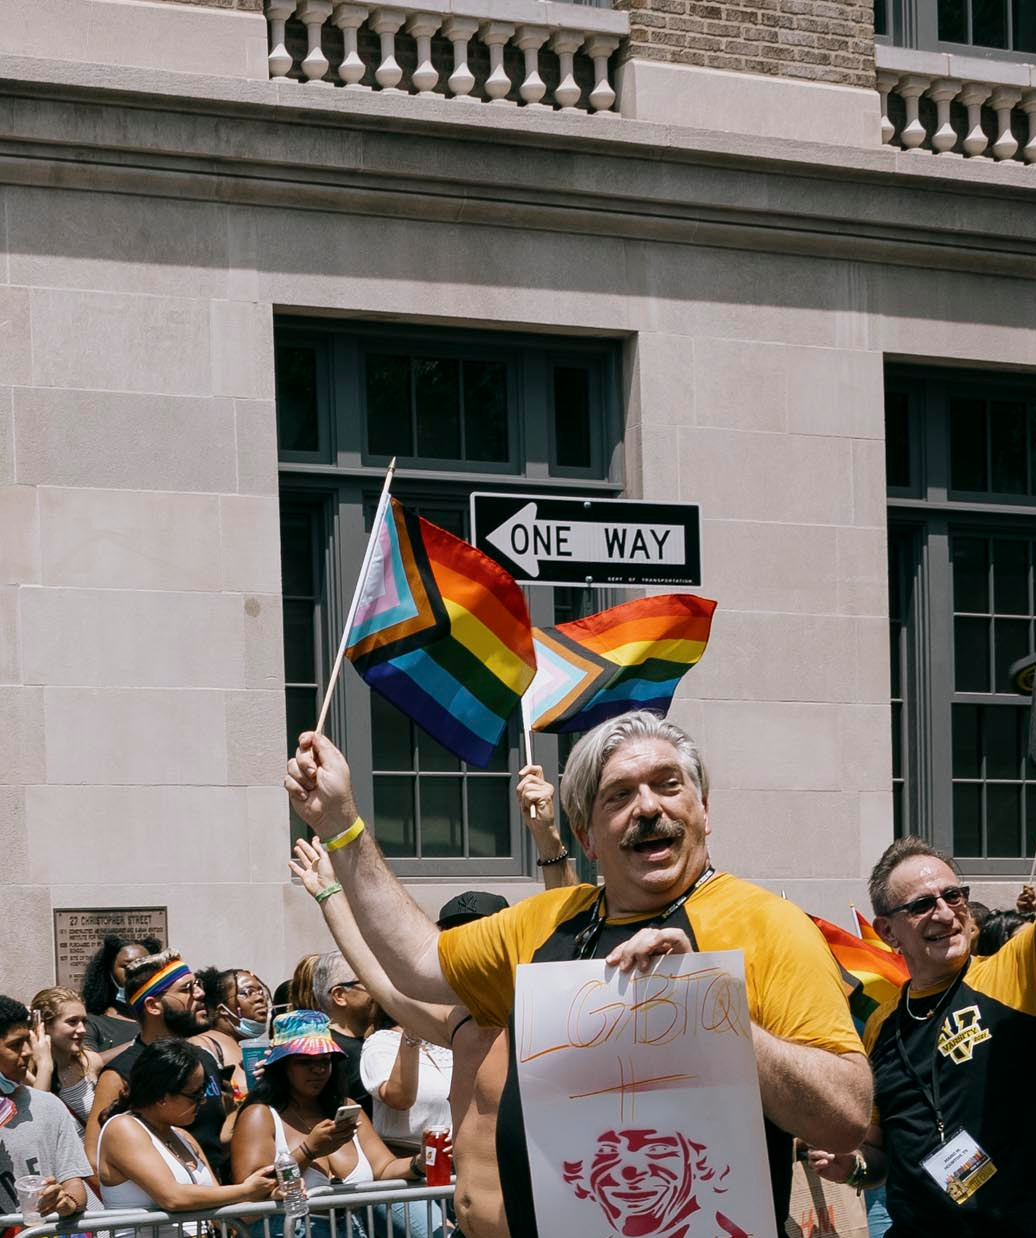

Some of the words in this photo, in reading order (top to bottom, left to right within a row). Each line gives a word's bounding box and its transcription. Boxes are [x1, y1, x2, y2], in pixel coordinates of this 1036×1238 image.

[511, 523, 573, 556] ONE
[604, 527, 671, 560] WAY
[128, 915, 152, 925] STREET
[941, 1027, 977, 1052] VARSITY
